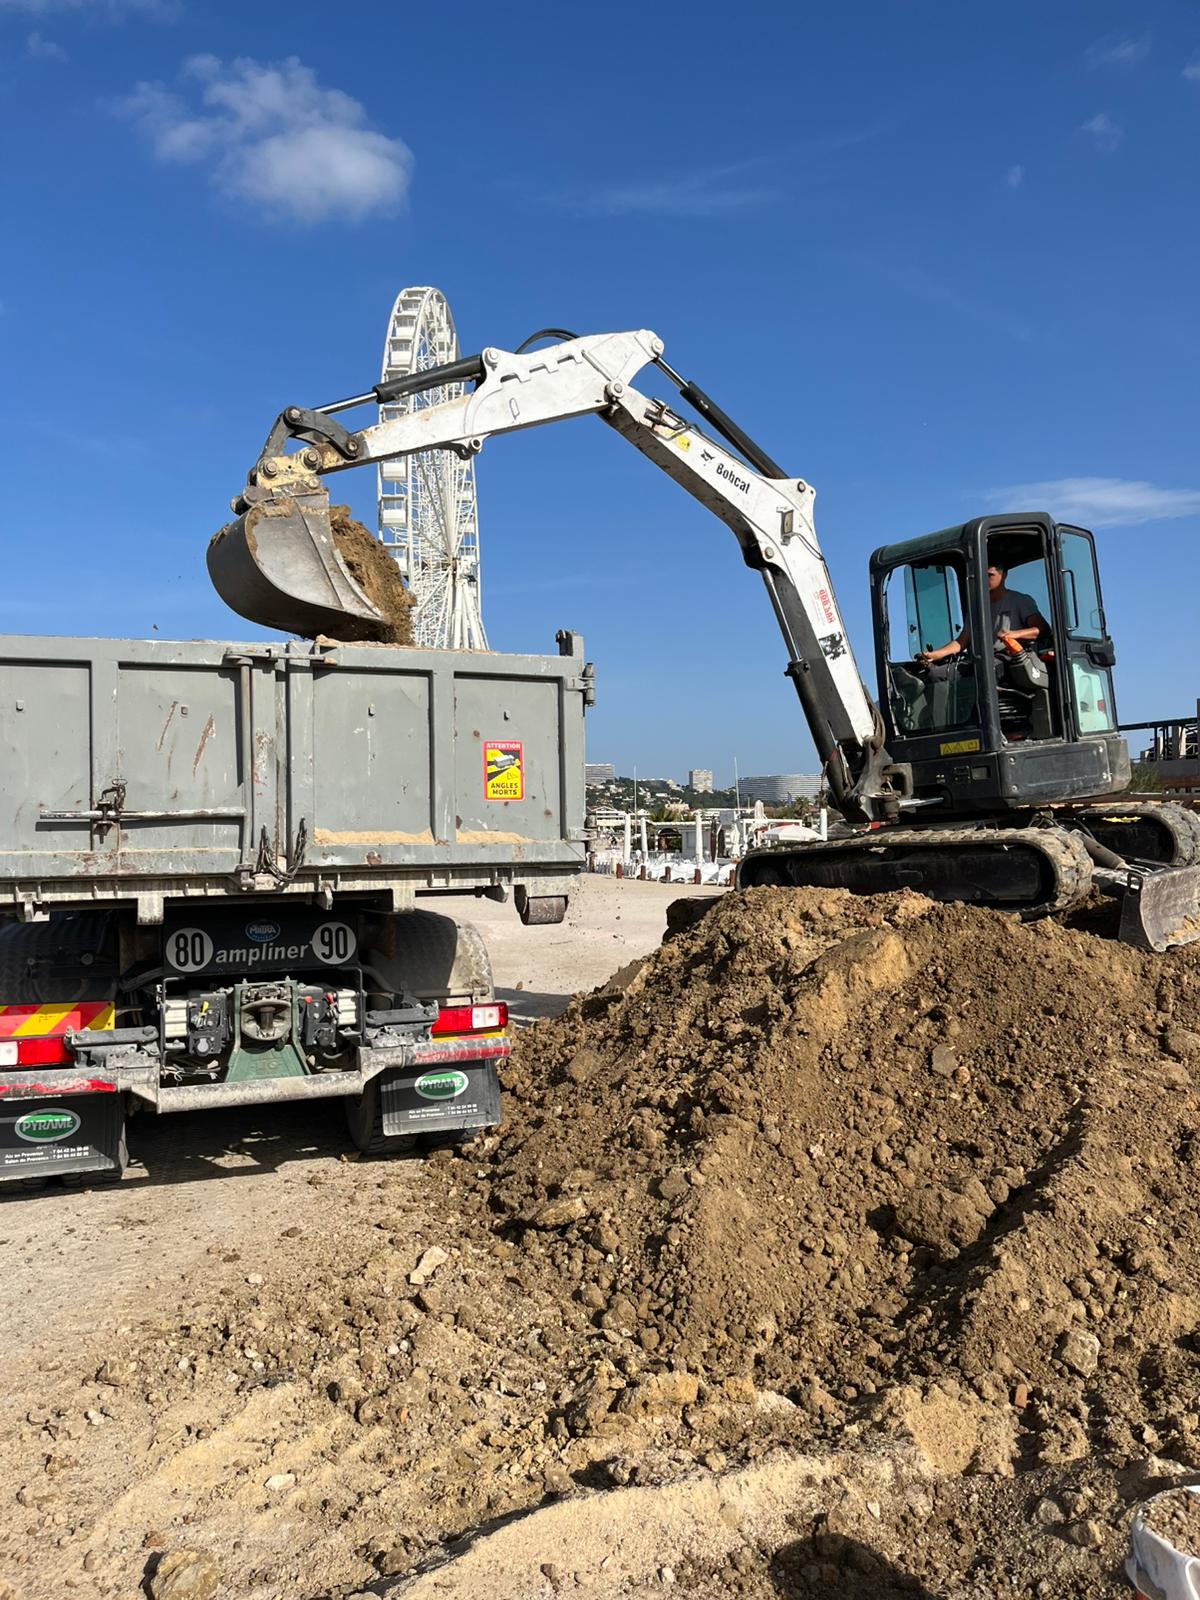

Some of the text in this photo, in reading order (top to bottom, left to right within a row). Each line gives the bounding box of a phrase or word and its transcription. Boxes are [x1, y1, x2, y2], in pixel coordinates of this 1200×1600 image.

[716, 463, 750, 494] Bobcat
[175, 932, 204, 967] 80
[215, 942, 308, 966] ampliner
[320, 926, 347, 960] 90
[421, 1077, 462, 1090] PYRAME
[22, 1117, 73, 1131] PYRAME
